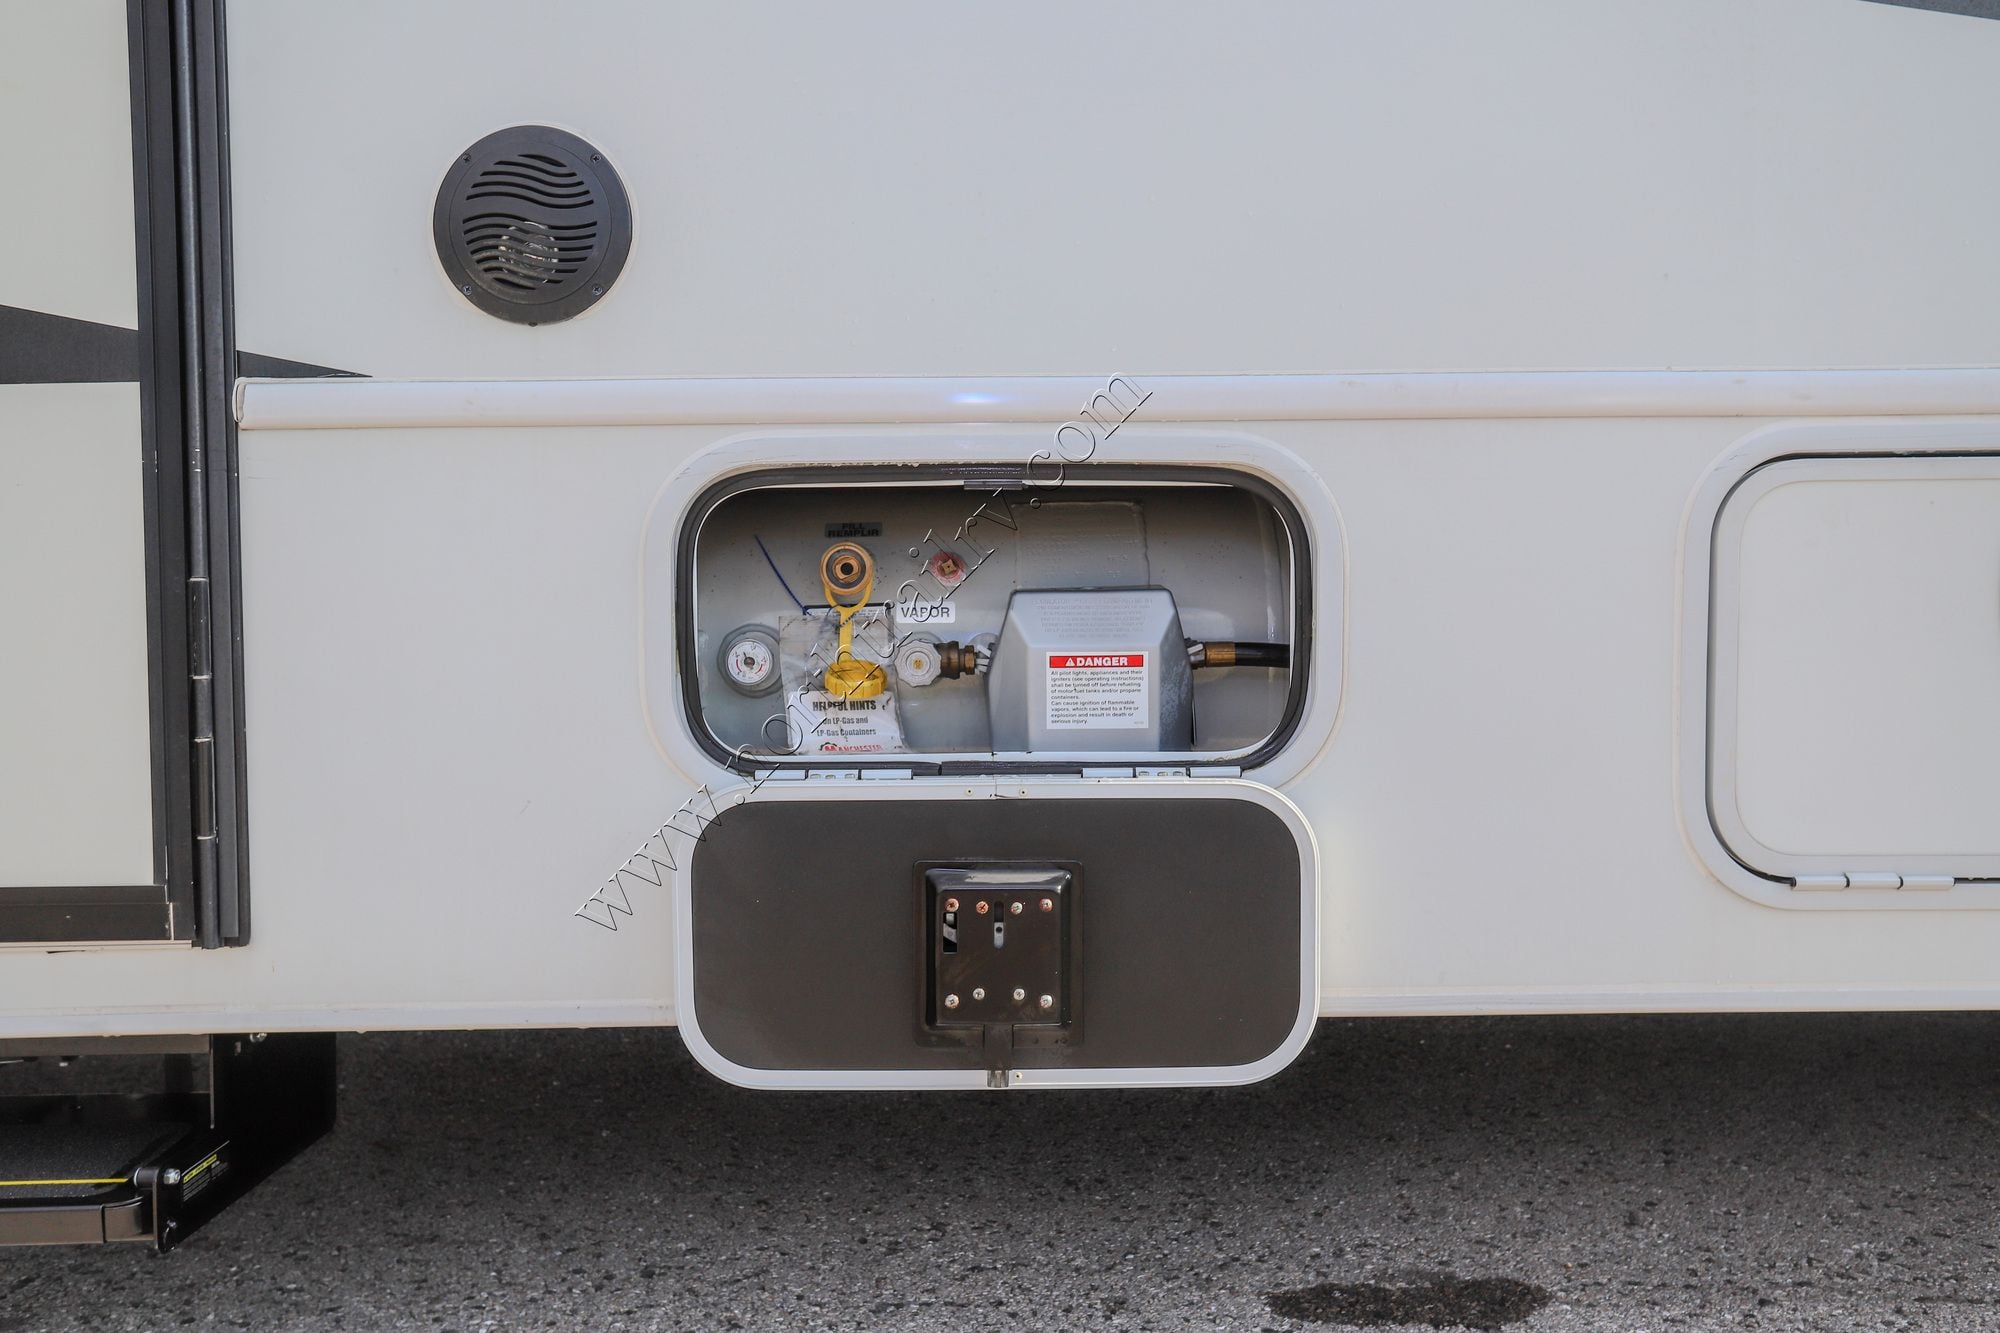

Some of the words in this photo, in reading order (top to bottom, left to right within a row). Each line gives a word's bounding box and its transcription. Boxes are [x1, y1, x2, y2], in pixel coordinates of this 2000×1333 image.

[827, 528, 879, 537] REMPLIR
[901, 606, 950, 618] VAPOR
[1076, 657, 1128, 666] DANGER
[812, 701, 848, 711] HELPFUL
[849, 700, 876, 710] HINTS
